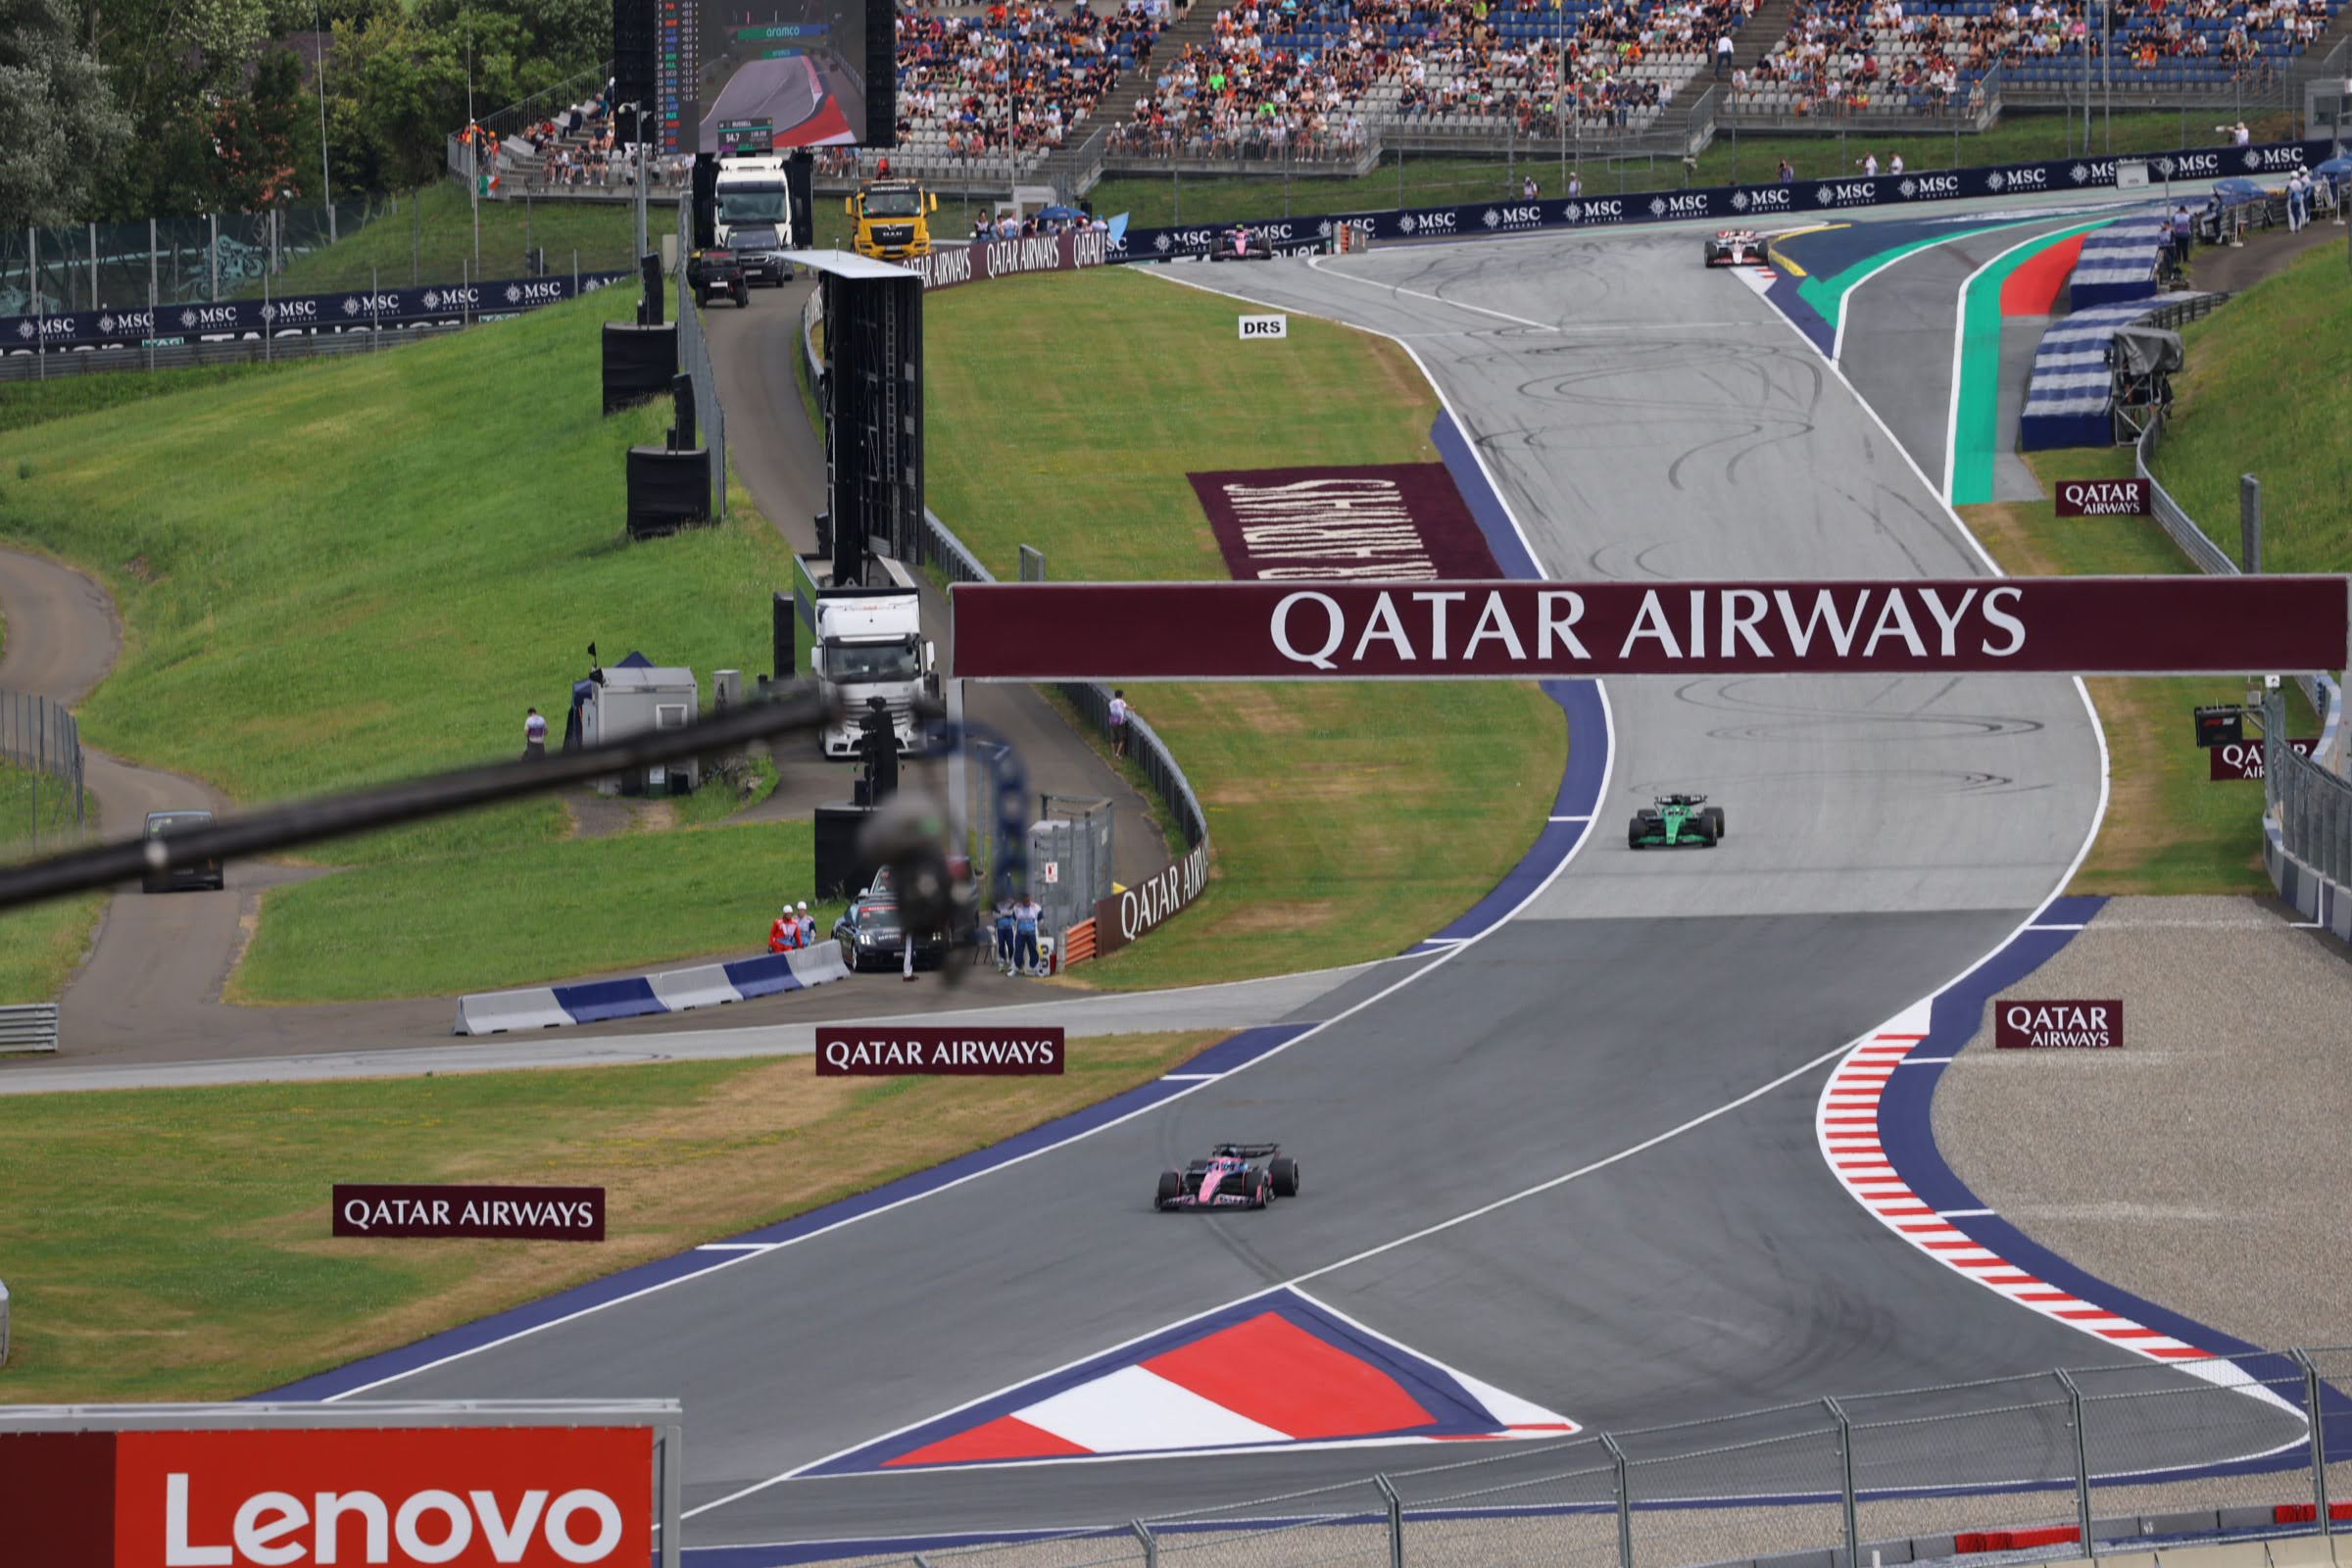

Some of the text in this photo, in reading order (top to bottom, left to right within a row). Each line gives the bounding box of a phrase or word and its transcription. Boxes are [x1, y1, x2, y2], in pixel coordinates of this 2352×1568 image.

[766, 25, 800, 37] aramco
[2179, 154, 2218, 171] MSC
[2264, 147, 2303, 164] MSC
[2007, 169, 2046, 185] MSC
[2090, 162, 2115, 177] MS
[1836, 183, 1876, 199] MSC
[1919, 176, 1958, 193] MSC
[1669, 195, 1707, 211] MSC
[1751, 189, 1789, 205] MSC
[1502, 206, 1541, 222] MSC
[1585, 201, 1622, 217] MSC
[1418, 212, 1456, 228] MSC
[1105, 235, 1128, 253] SC
[1173, 230, 1211, 247] MSC
[986, 240, 1018, 278] QATAR
[1019, 235, 1059, 270] AIRWAYS
[933, 247, 971, 286] AIRWAYS
[442, 288, 479, 304] MSC
[524, 282, 562, 298] MSC
[279, 301, 317, 317] MSC
[362, 295, 400, 311] MSC
[118, 313, 154, 328] MSC
[199, 307, 237, 323] MSC
[38, 318, 75, 334] MSC
[1244, 321, 1281, 334] DRS
[2065, 483, 2138, 506] QATAR
[2083, 502, 2140, 514] AIRWAYS
[1270, 587, 2027, 669] QATAR AIRWAYS
[1121, 865, 1180, 941] QATAR
[2007, 1005, 2109, 1035] QATAR
[2031, 1031, 2110, 1047] AIRWAYS
[825, 1041, 1054, 1070] QATAR AIRWAYS
[344, 1199, 593, 1230] QATAR AIRWAYS
[166, 1472, 623, 1567] Lenovo
